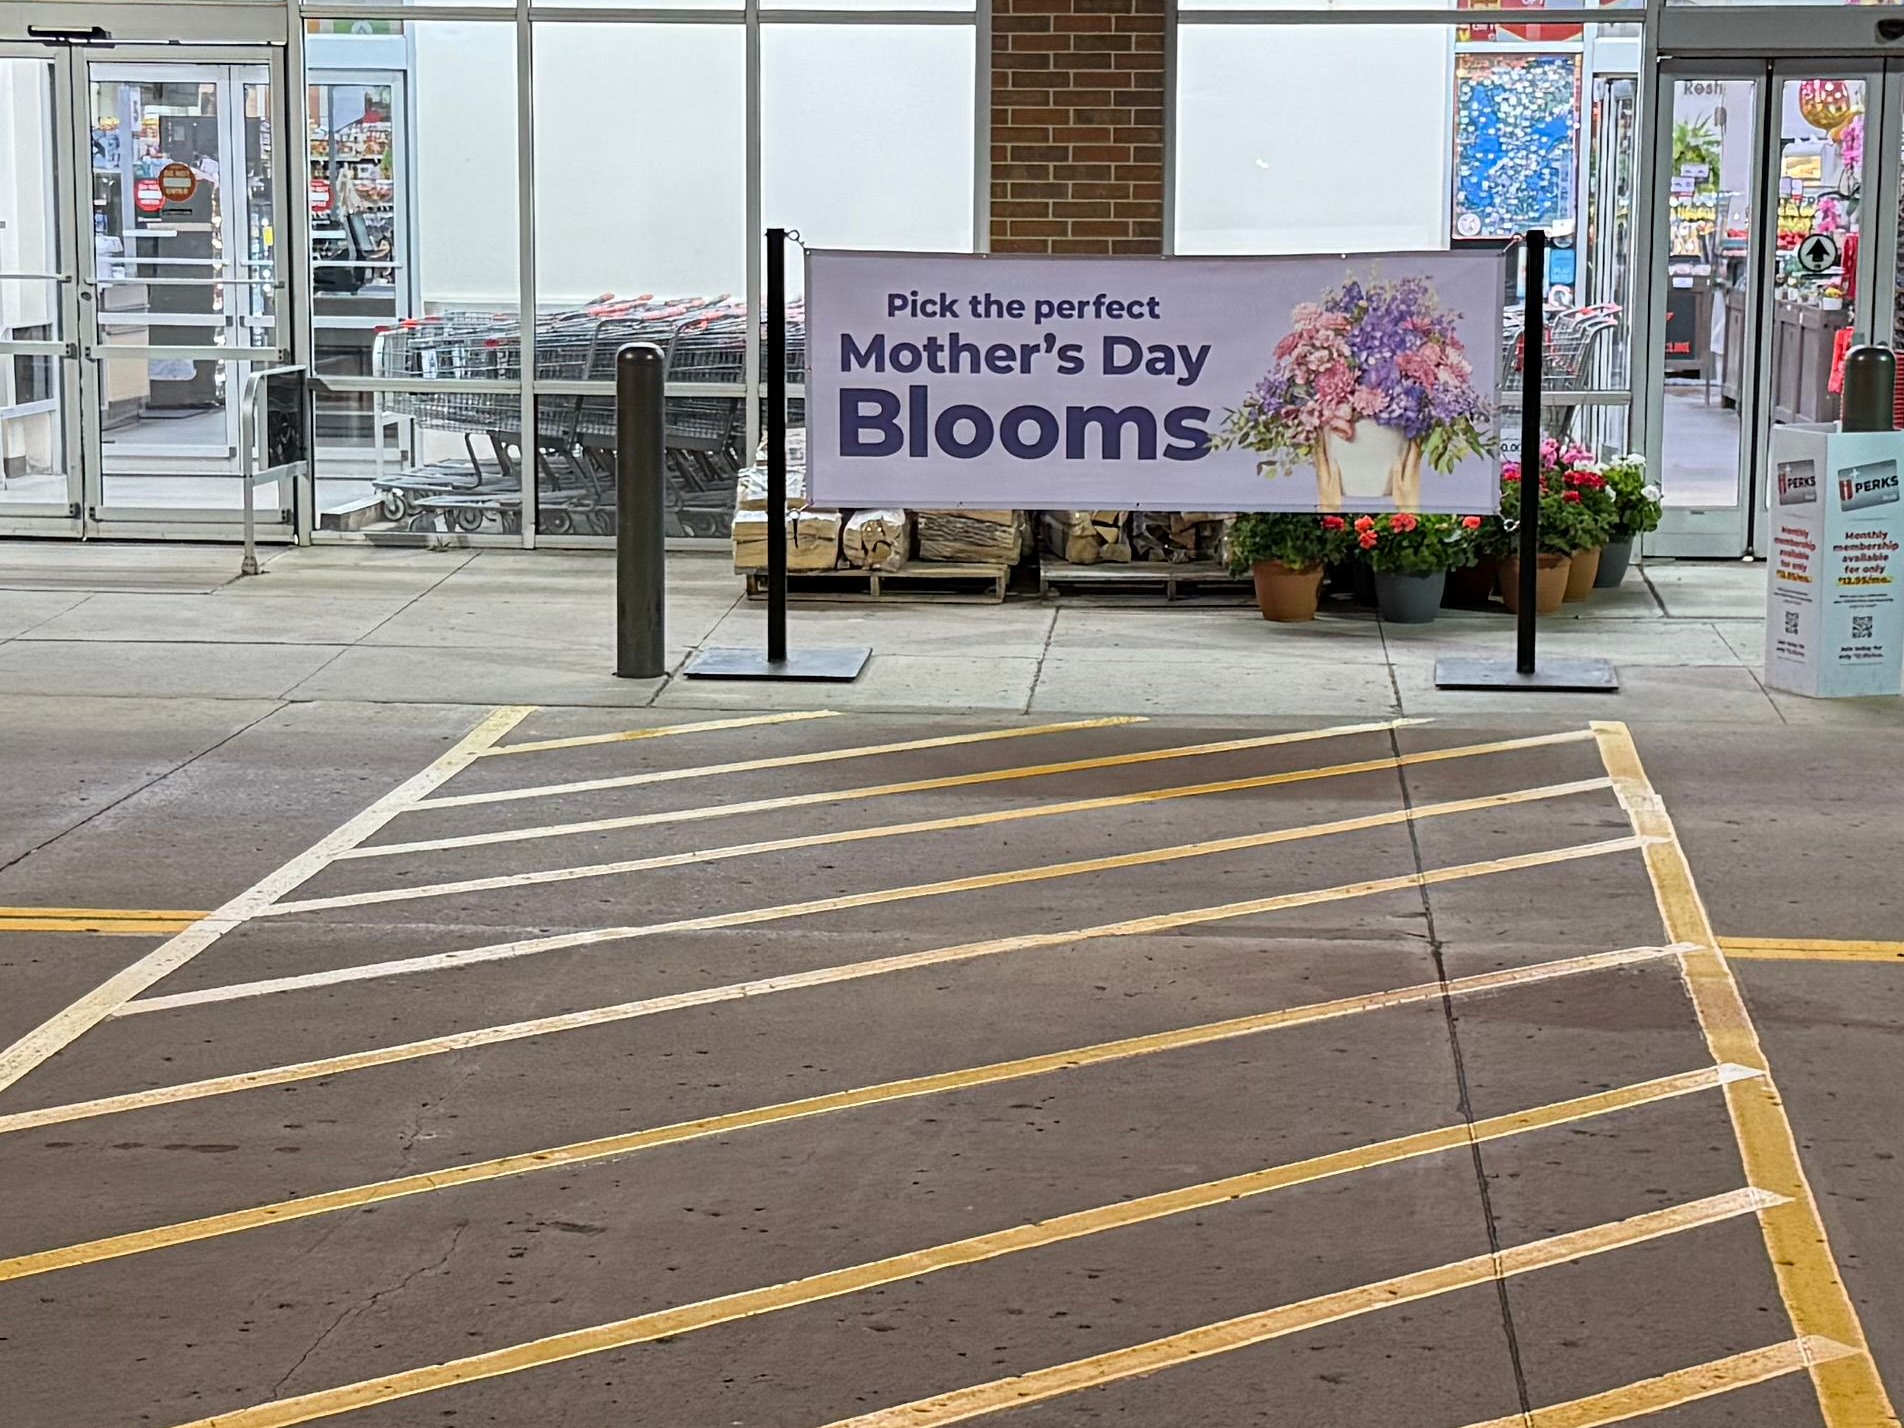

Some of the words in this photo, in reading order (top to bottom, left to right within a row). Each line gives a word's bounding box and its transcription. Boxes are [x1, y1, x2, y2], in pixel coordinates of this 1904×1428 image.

[887, 292, 960, 319] Pick
[968, 292, 1026, 319] the
[1034, 293, 1161, 325] perfect
[839, 332, 1085, 375] Mother's
[1102, 335, 1212, 387] Day
[839, 384, 1213, 461] Blooms
[1787, 474, 1816, 490] PERKS
[1855, 475, 1899, 494] PERKS
[1845, 530, 1889, 541] Monthly
[1833, 540, 1900, 552] membership
